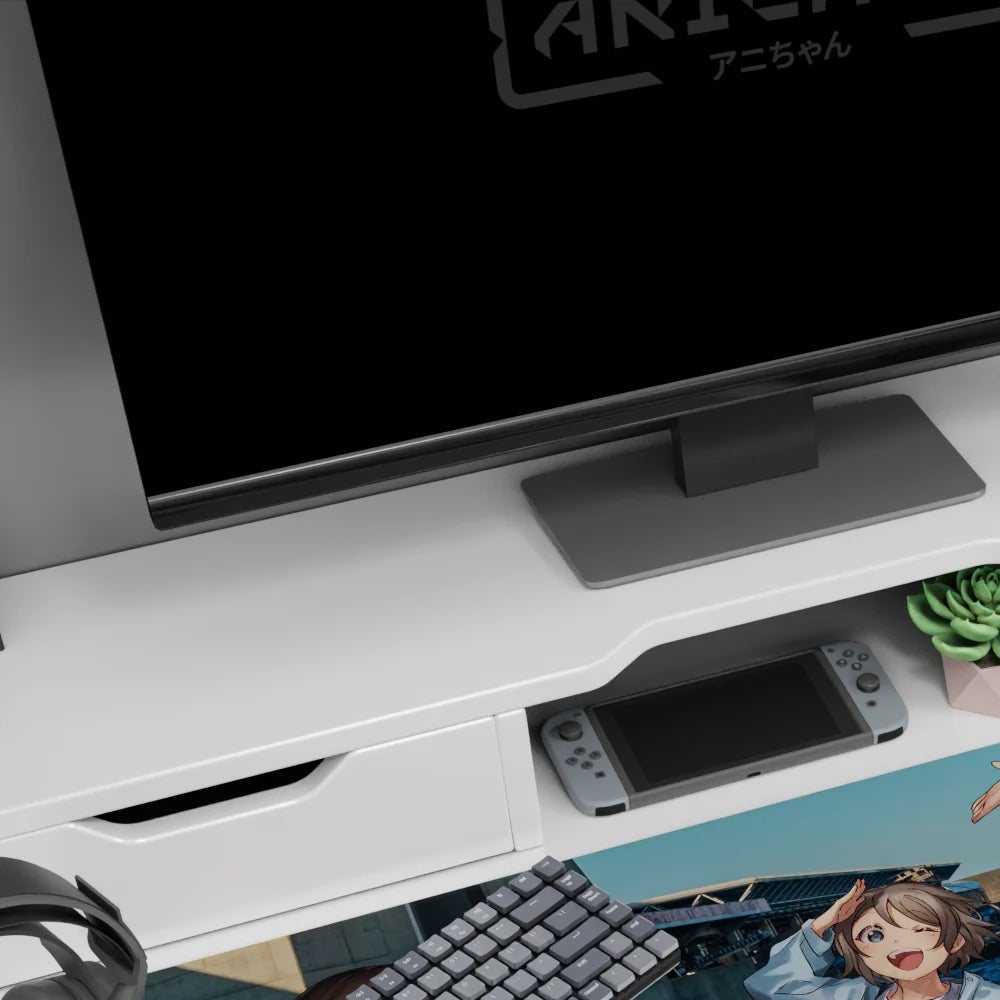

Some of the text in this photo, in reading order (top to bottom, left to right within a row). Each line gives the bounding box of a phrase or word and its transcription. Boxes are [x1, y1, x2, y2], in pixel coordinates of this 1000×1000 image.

[708, 30, 852, 81] アニちゃん
